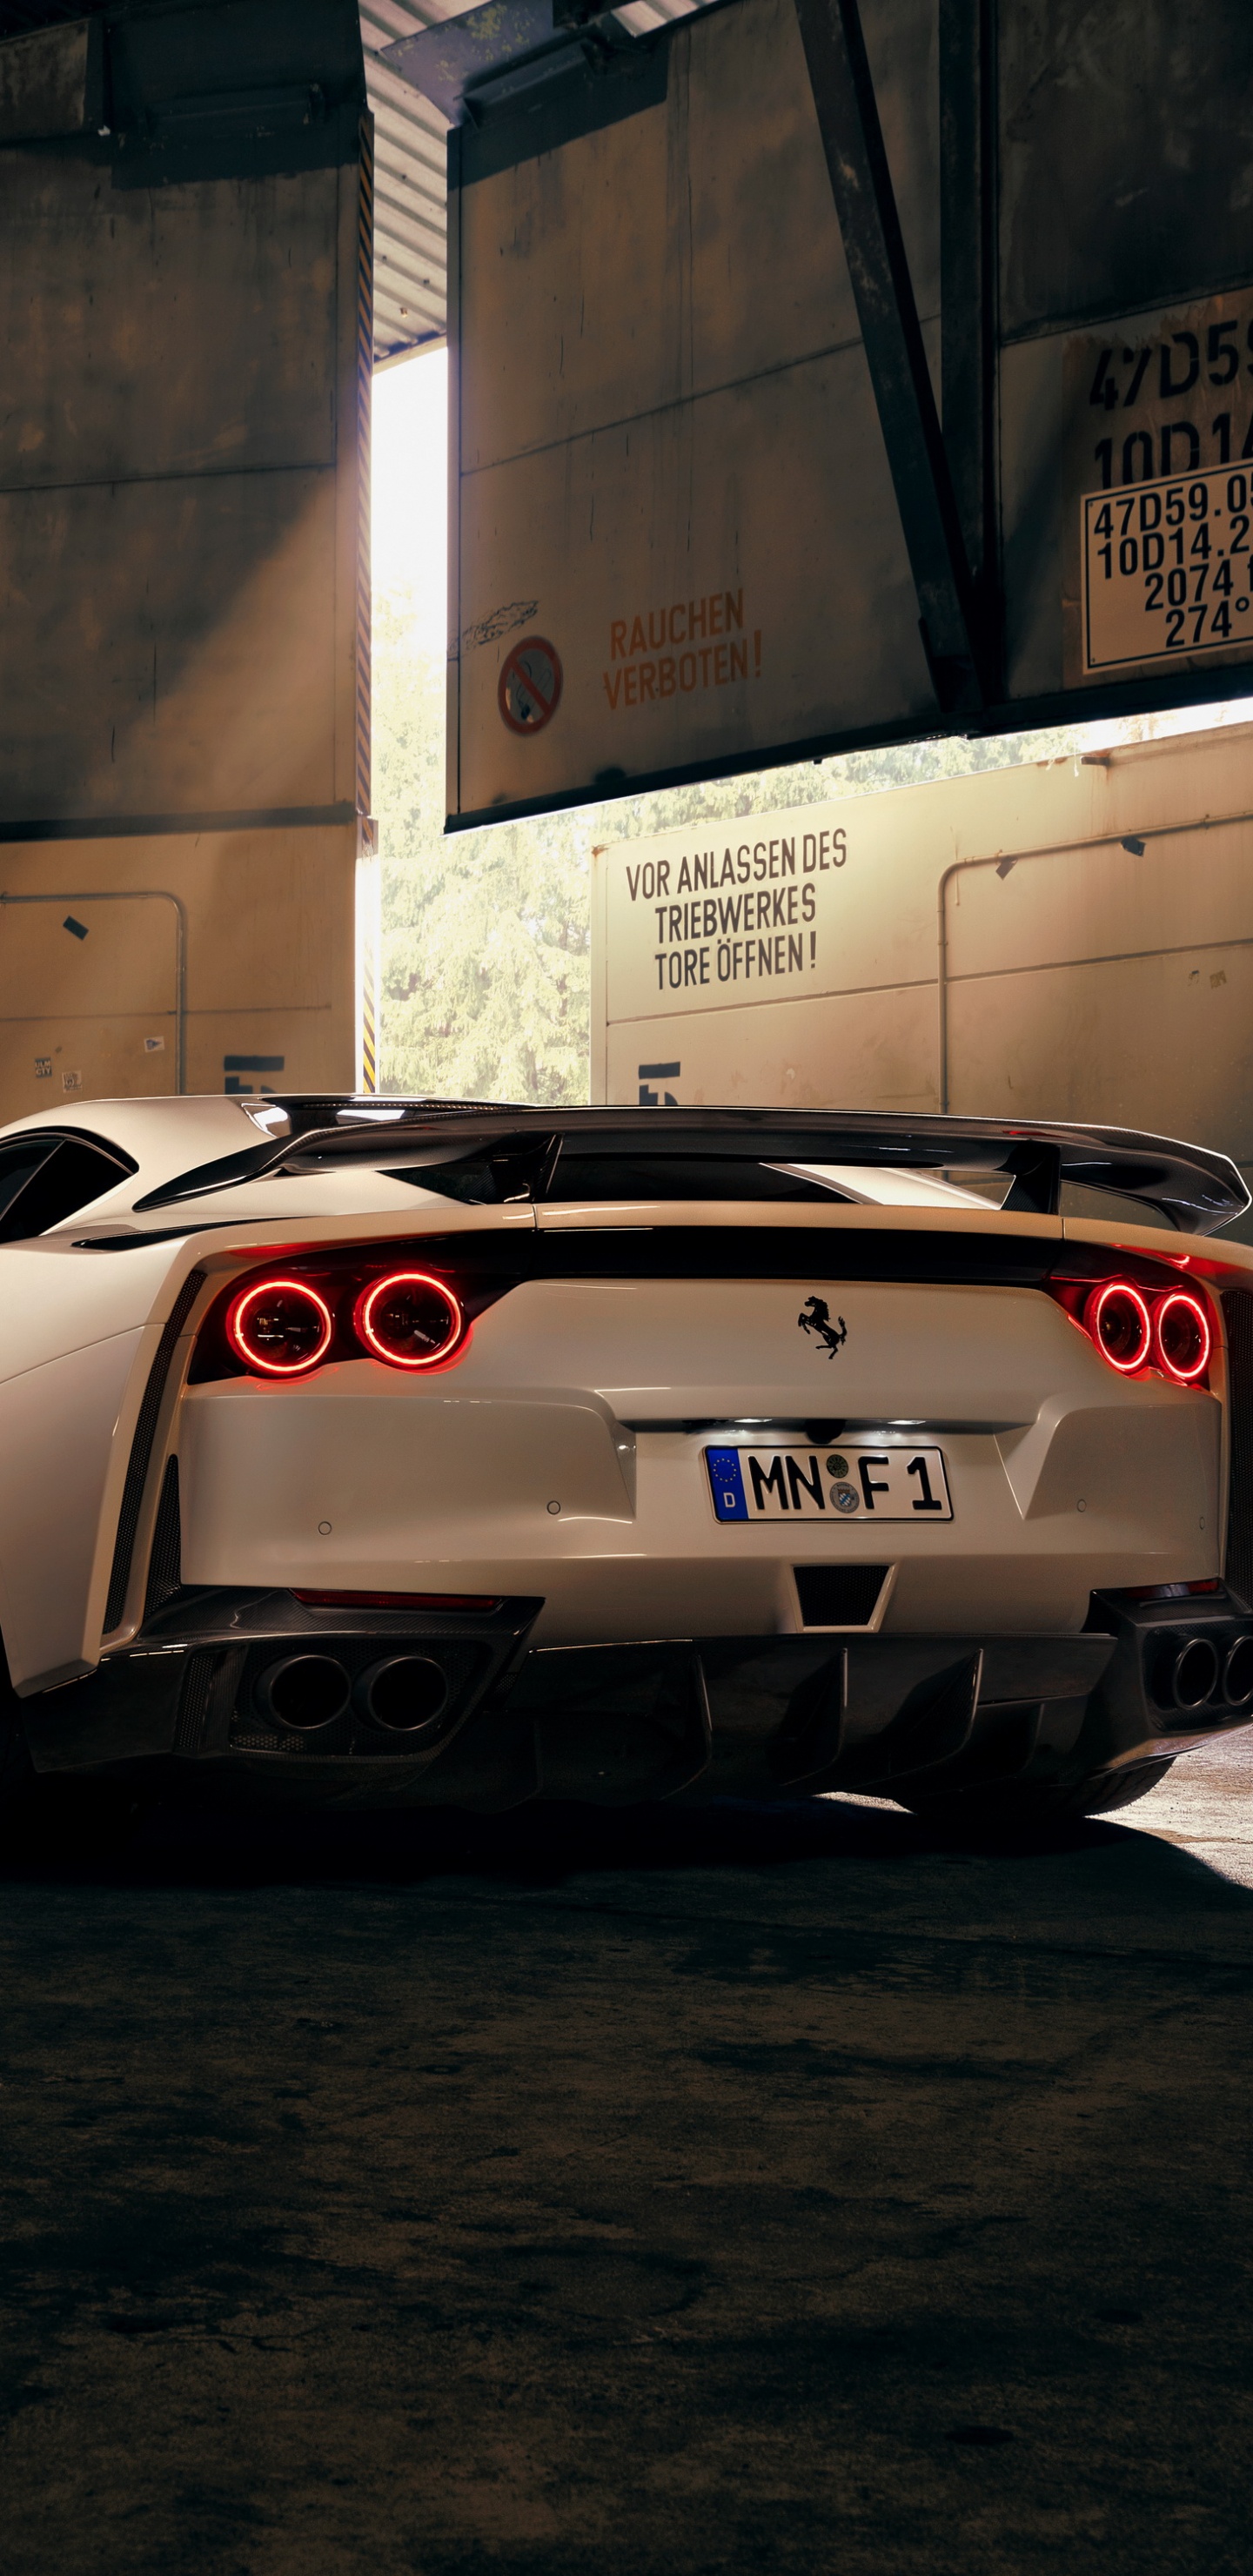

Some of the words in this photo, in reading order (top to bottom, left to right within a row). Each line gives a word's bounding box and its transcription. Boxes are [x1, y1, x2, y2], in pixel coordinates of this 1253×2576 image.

[1090, 319, 1253, 410] 47D5
[1094, 473, 1253, 539] 47D59.0
[1097, 515, 1250, 580] 10D14.2
[1145, 560, 1234, 611] 2074
[610, 588, 744, 661] RAUCHEN
[1166, 597, 1250, 647] 274°
[626, 860, 670, 902] VOR
[677, 842, 795, 894] ANLASSEN
[802, 828, 847, 873] DES
[654, 882, 816, 944] TRIEBWERKES
[654, 947, 710, 989] TORE
[723, 1492, 736, 1507] D
[747, 1454, 826, 1510] MN
[857, 1455, 889, 1510] F
[907, 1456, 942, 1510] 1
